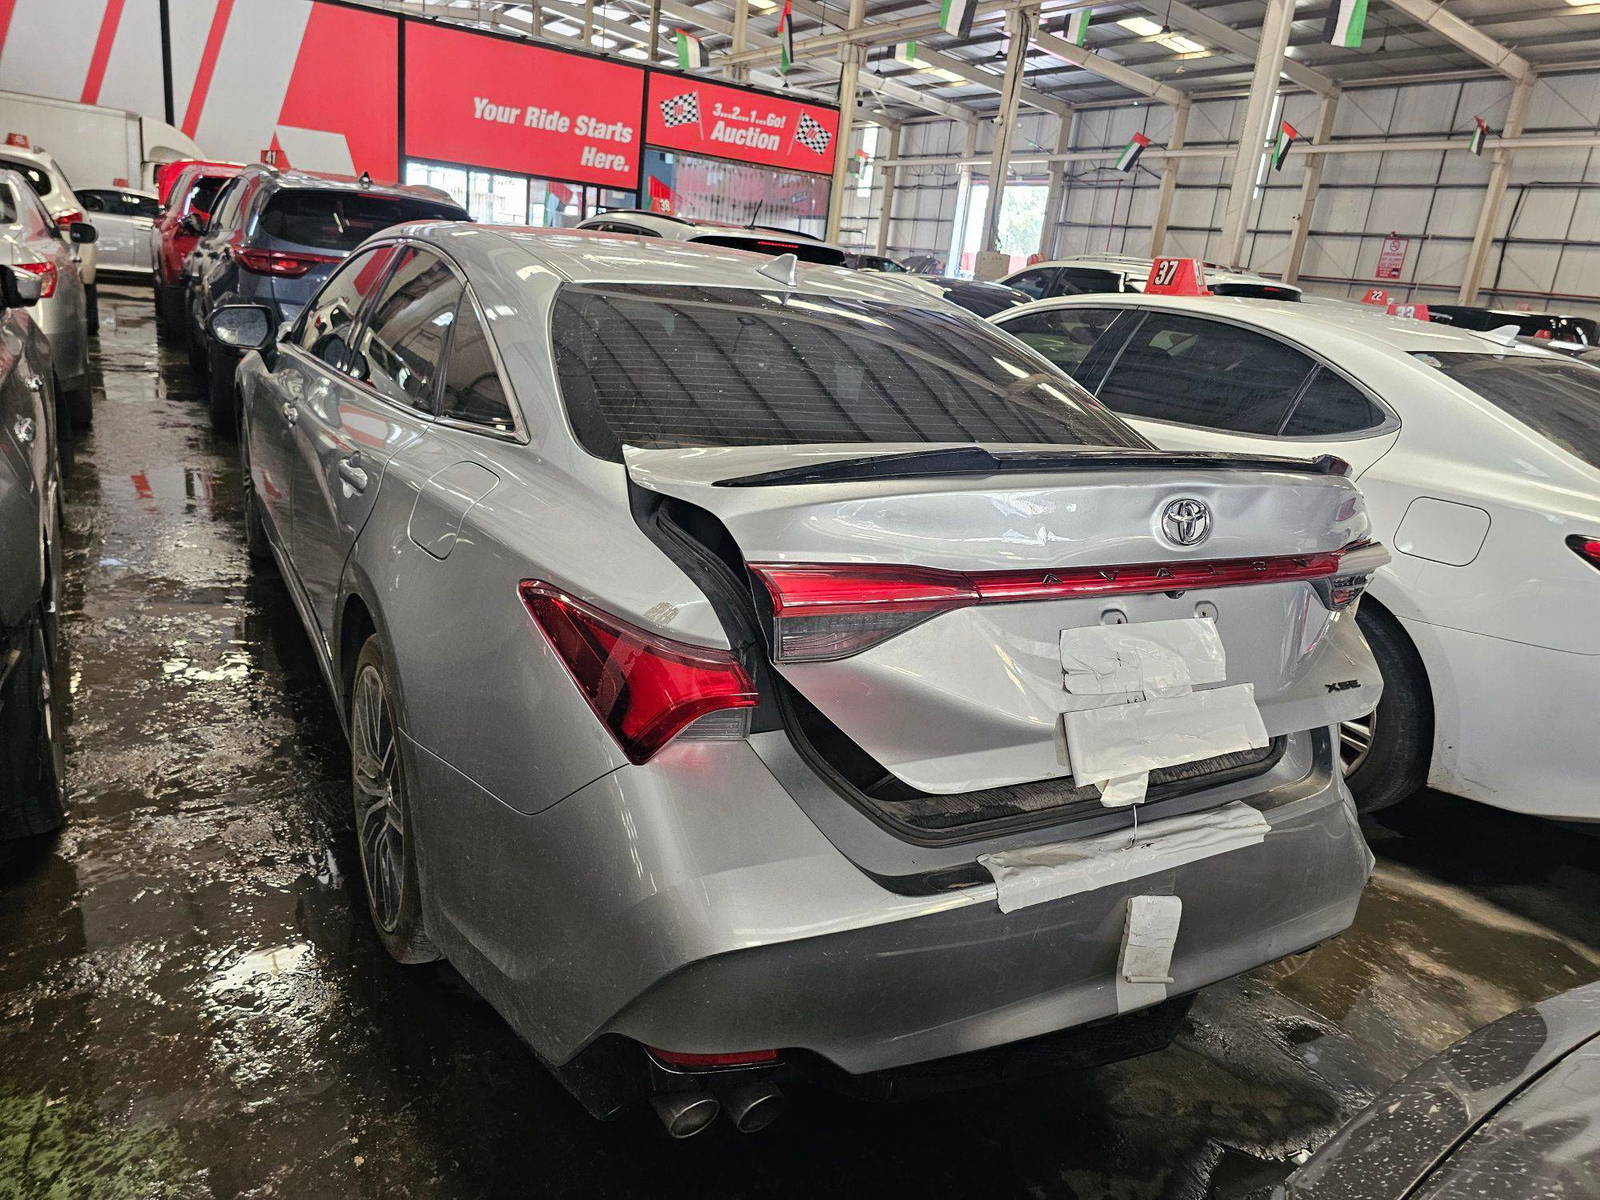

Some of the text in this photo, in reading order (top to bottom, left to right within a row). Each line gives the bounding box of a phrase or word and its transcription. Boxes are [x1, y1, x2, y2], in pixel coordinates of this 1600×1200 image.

[473, 97, 633, 143] Your Ride Starts
[710, 121, 780, 151] Auction
[580, 146, 630, 172] Here.
[1154, 260, 1179, 285] 37
